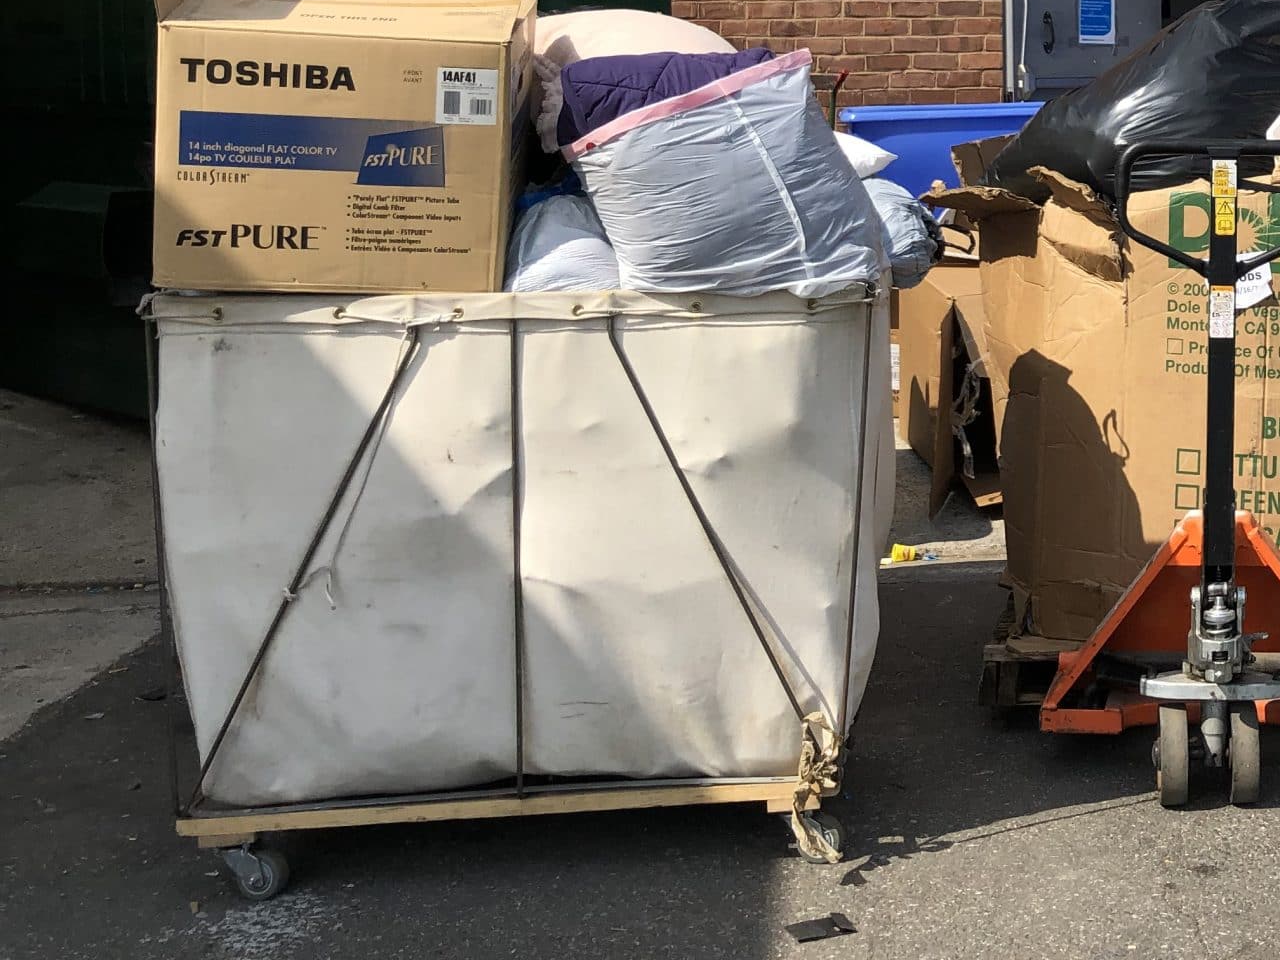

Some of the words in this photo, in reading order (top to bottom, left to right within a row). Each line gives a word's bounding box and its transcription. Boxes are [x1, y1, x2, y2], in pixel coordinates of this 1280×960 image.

[180, 58, 356, 91] TOSHIBA
[442, 71, 476, 83] 14AF41
[189, 141, 200, 150] 14
[203, 142, 221, 151] inch
[224, 143, 264, 155] diagonal
[267, 145, 288, 154] FLAT
[291, 146, 322, 155] COLOR
[325, 147, 337, 155] TV
[188, 153, 212, 163] 14po
[215, 154, 226, 162] TV
[229, 155, 272, 164] COULEUR
[275, 156, 296, 165] PLAT
[1241, 271, 1262, 282] ODS
[1168, 300, 1201, 313] Dole
[1244, 322, 1266, 335] CA
[1256, 344, 1274, 358] Of
[1165, 359, 1208, 374] Produ
[1234, 363, 1250, 378] Of
